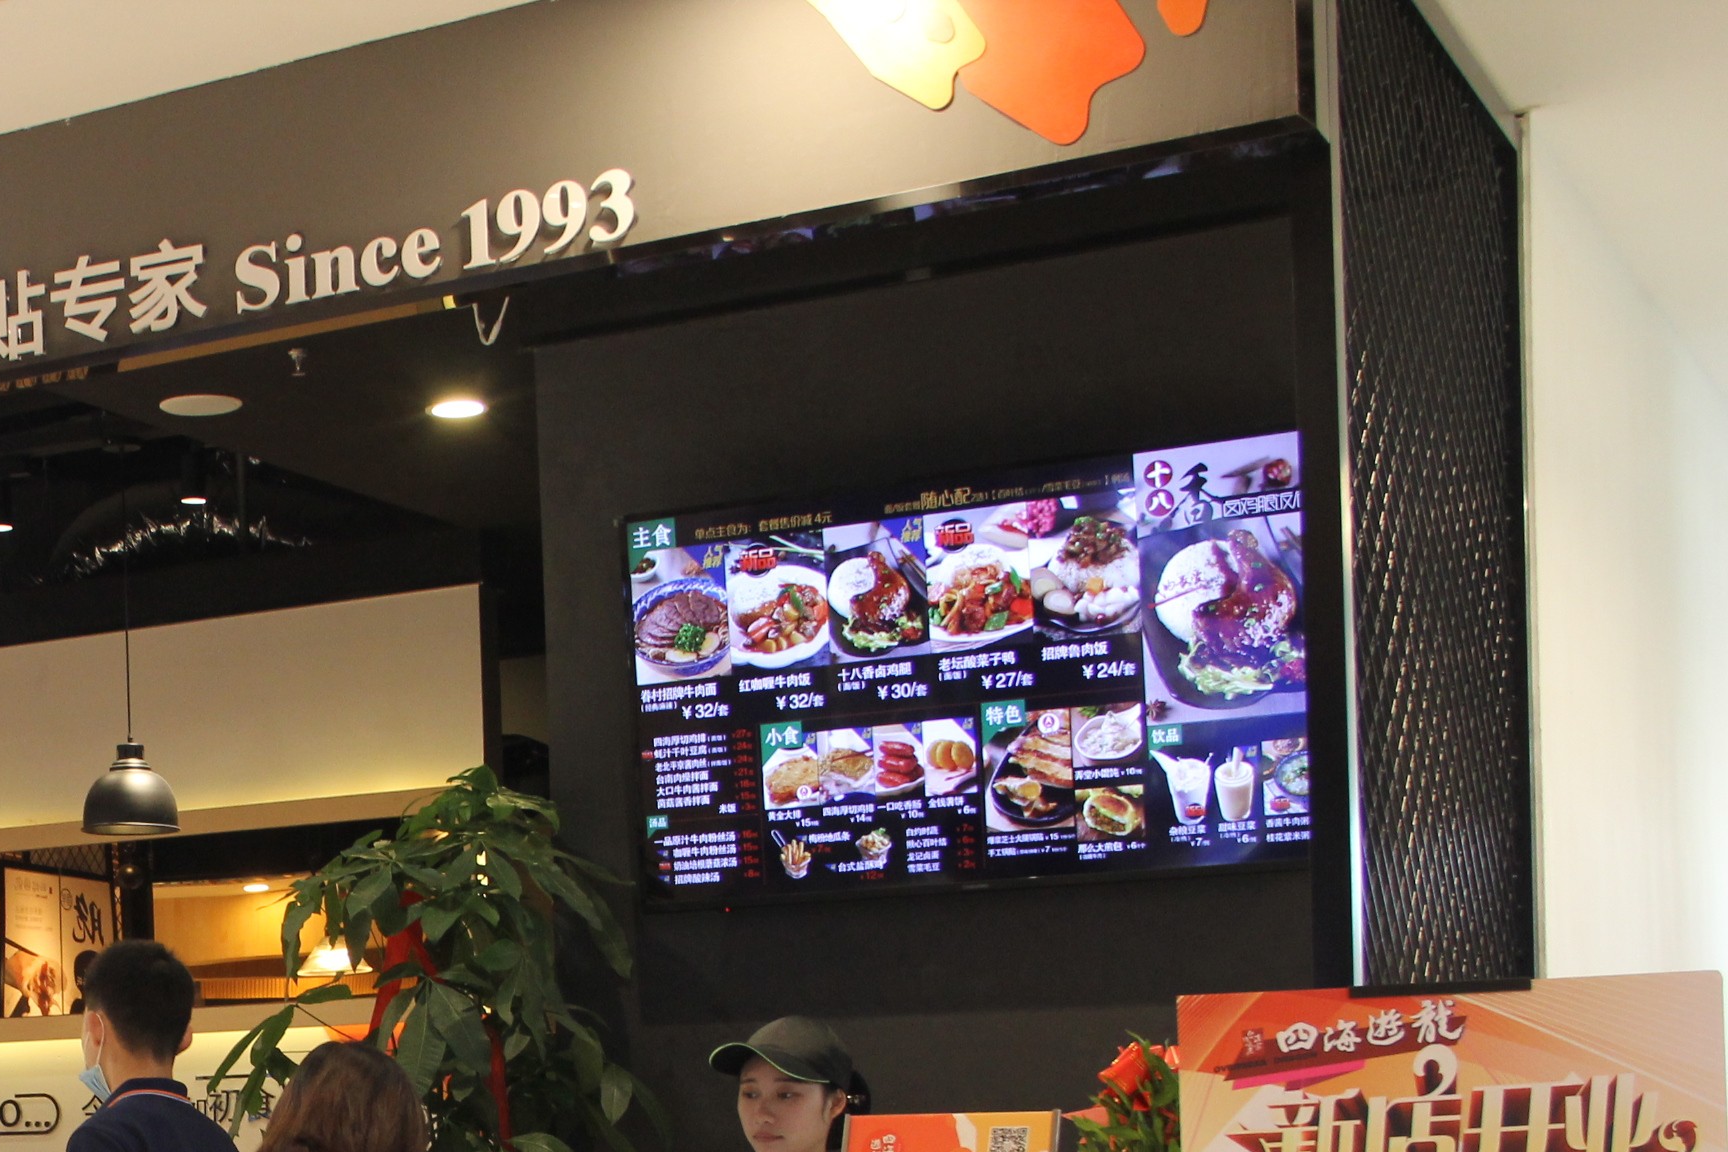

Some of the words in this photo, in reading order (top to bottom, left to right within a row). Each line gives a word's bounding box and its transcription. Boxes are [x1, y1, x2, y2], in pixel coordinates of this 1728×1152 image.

[234, 226, 442, 314] Since
[460, 168, 638, 272] 1993
[632, 523, 672, 550] 主食
[985, 704, 1022, 726] 特色
[765, 725, 799, 747] 小食
[1151, 727, 1179, 745] 饮品
